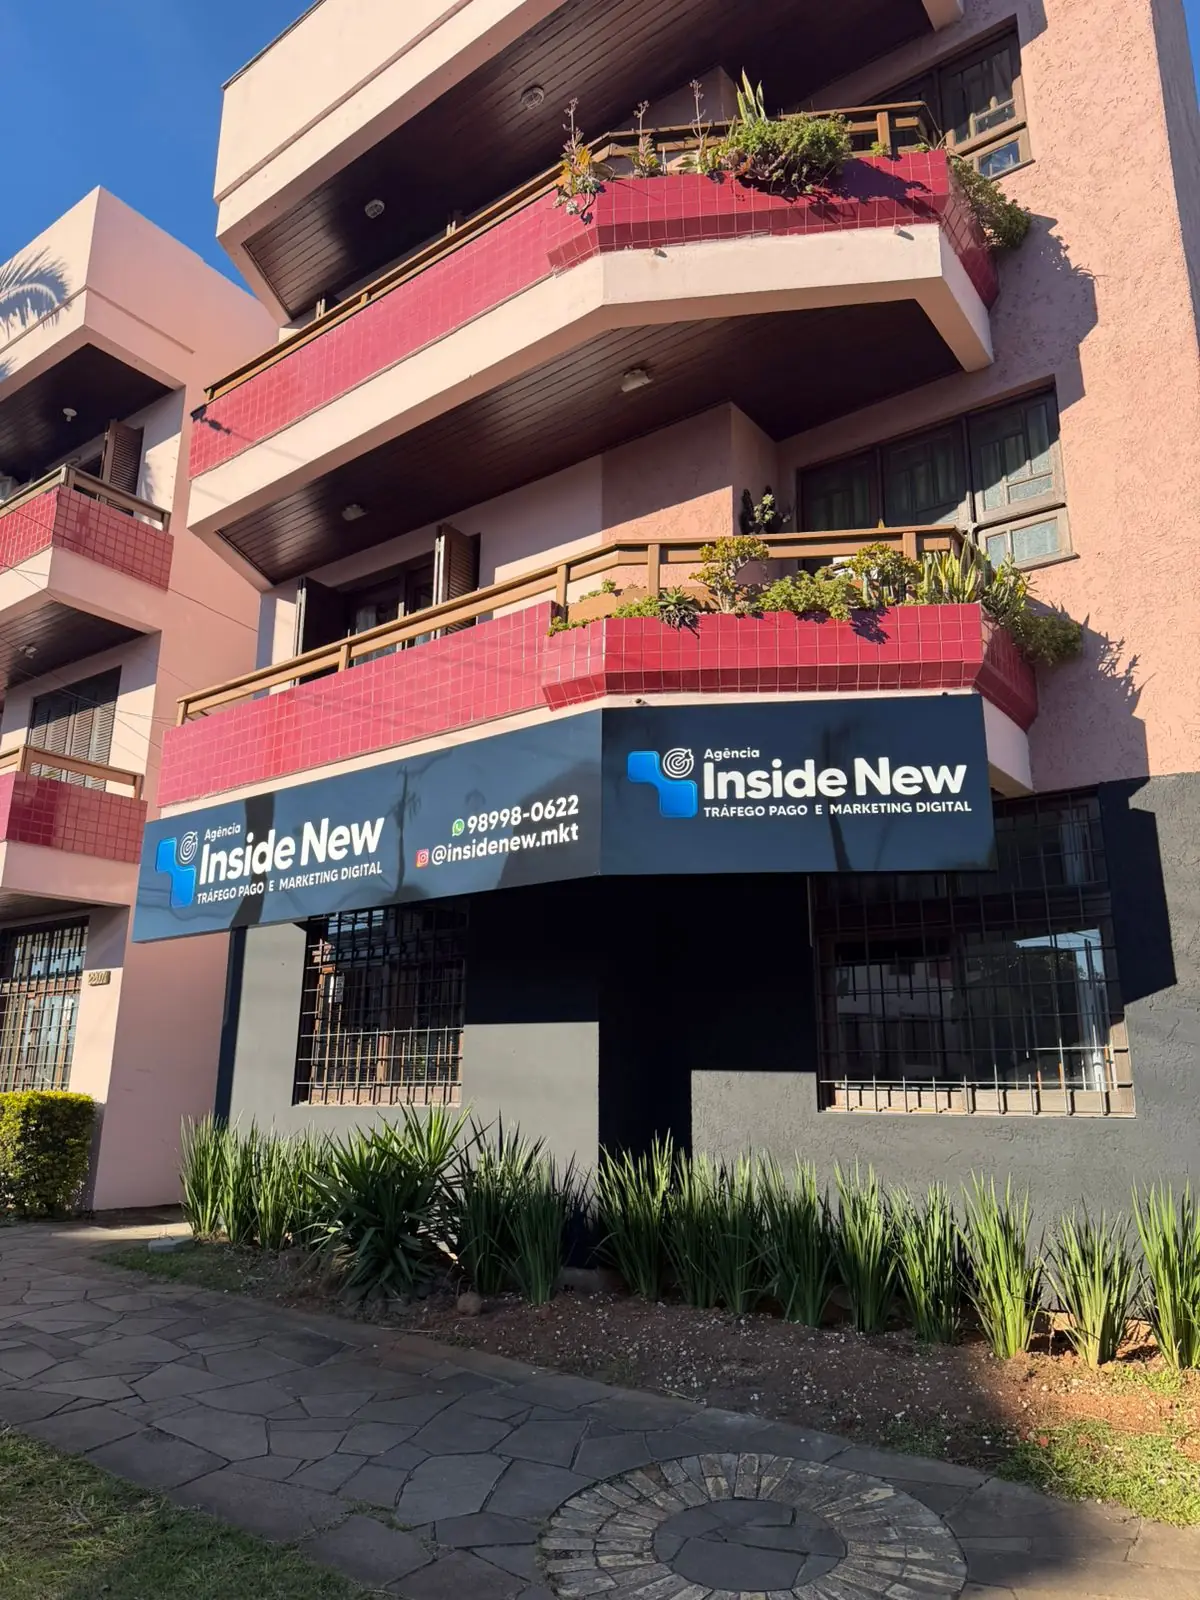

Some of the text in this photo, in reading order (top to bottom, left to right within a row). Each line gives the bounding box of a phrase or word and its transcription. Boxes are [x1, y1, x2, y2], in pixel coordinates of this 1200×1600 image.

[703, 747, 761, 761] Agência
[703, 756, 968, 800] Inside New
[467, 794, 579, 834] 98998-0622
[703, 800, 973, 818] TRÁFEGO PAGO E MARKETING DIGITAL
[199, 817, 385, 885] Inside New
[431, 822, 579, 866] @insidenew.mkt
[197, 861, 383, 905] TRÁFEGO PAGO E MARKETING DIGITAL
